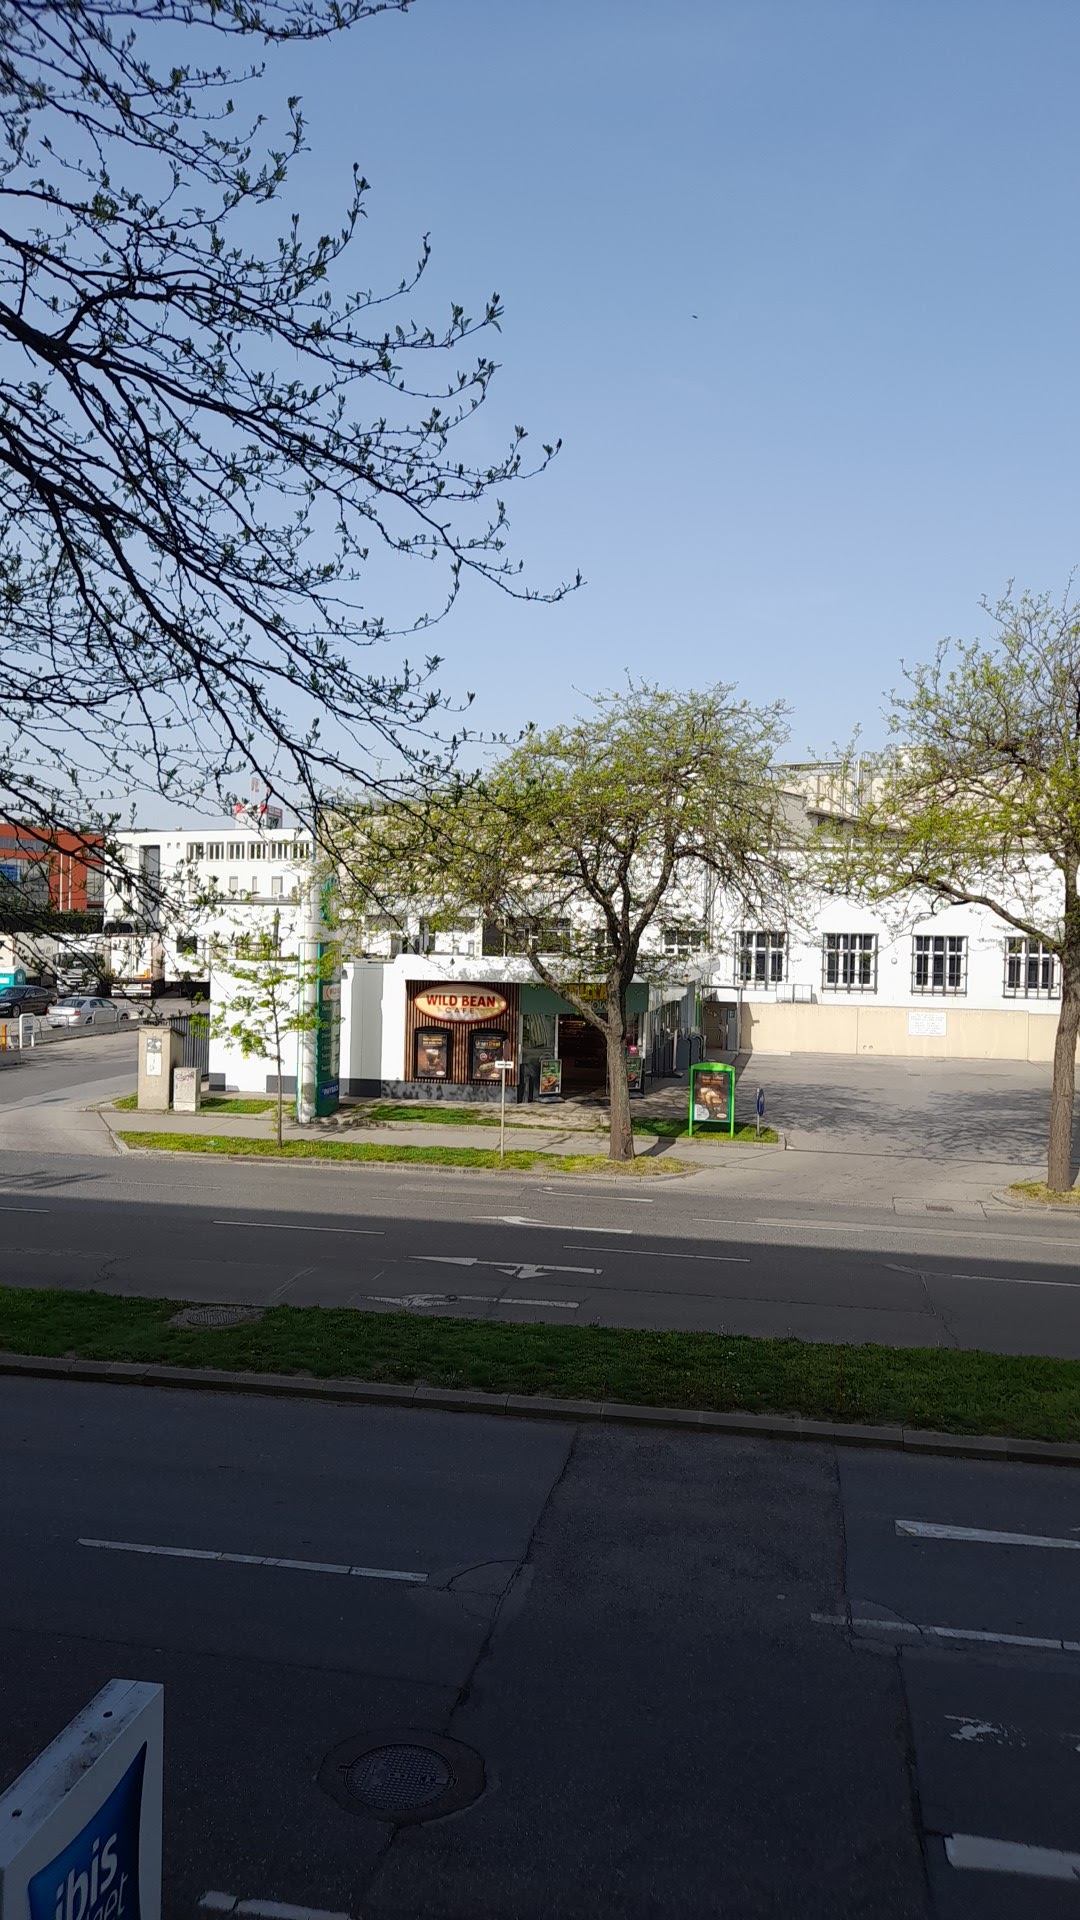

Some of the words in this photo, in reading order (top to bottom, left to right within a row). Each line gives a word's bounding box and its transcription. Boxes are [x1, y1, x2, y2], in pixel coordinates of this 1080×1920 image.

[426, 994, 458, 1007] WILD
[461, 995, 496, 1008] BEAN
[55, 1832, 118, 1920] ibis
